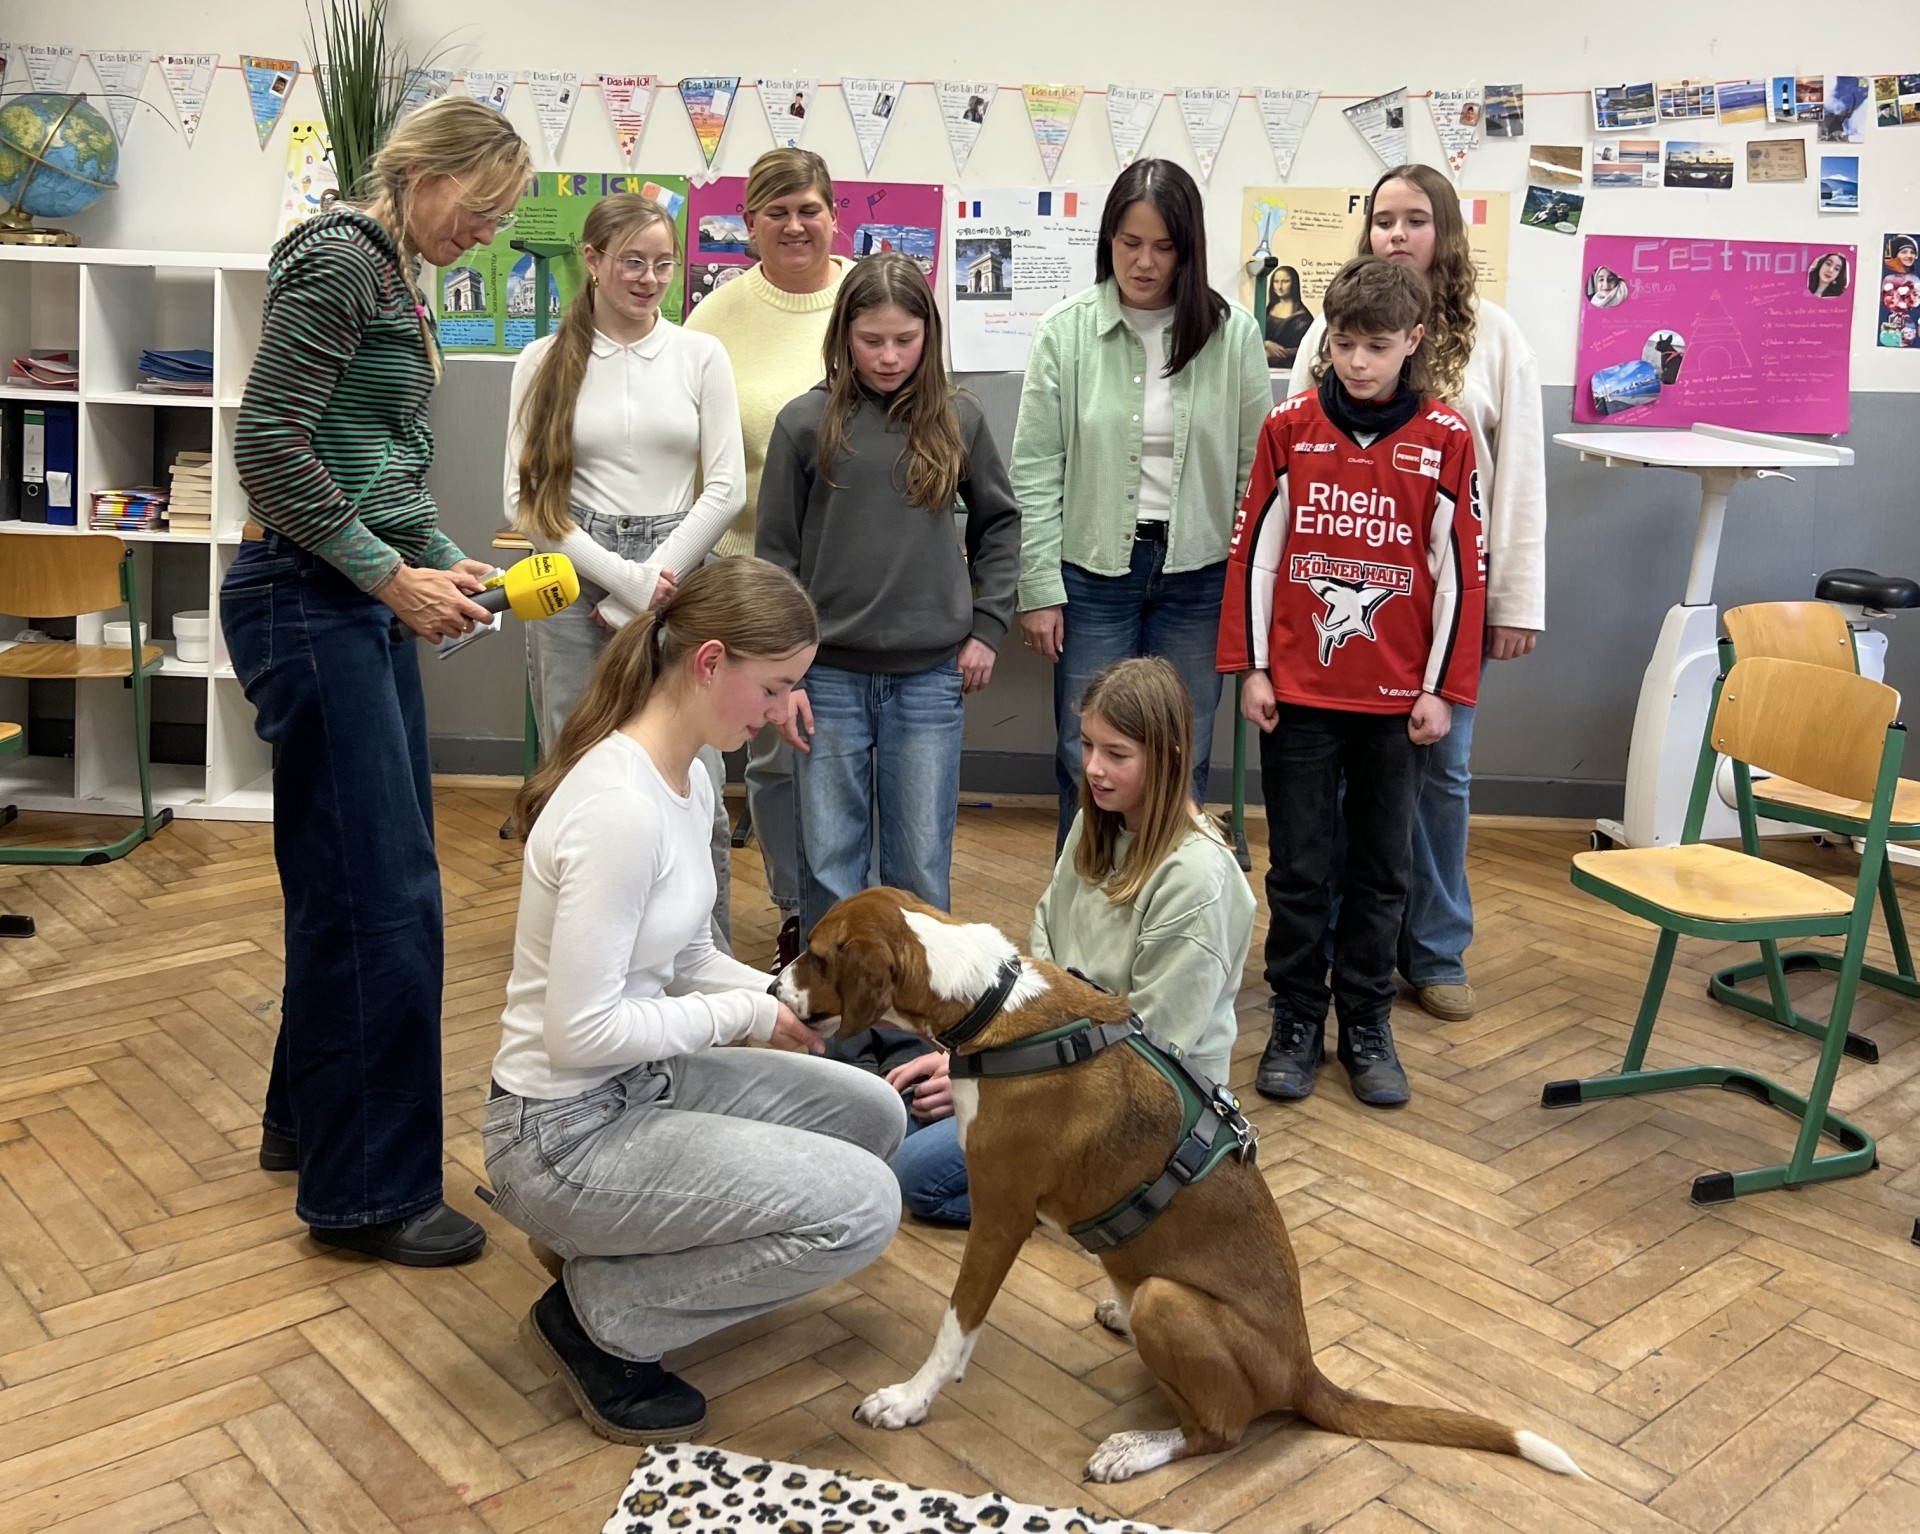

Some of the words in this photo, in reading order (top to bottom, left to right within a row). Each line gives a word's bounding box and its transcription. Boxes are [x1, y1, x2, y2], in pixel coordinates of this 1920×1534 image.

[607, 77, 623, 86] Das
[623, 77, 635, 86] bin
[636, 77, 649, 86] ICH
[1308, 482, 1396, 519] Rhein
[1295, 505, 1413, 548] Energie
[1294, 556, 1361, 580] KÖLNER
[1364, 566, 1409, 591] HAIE
[550, 586, 564, 608] Radio
